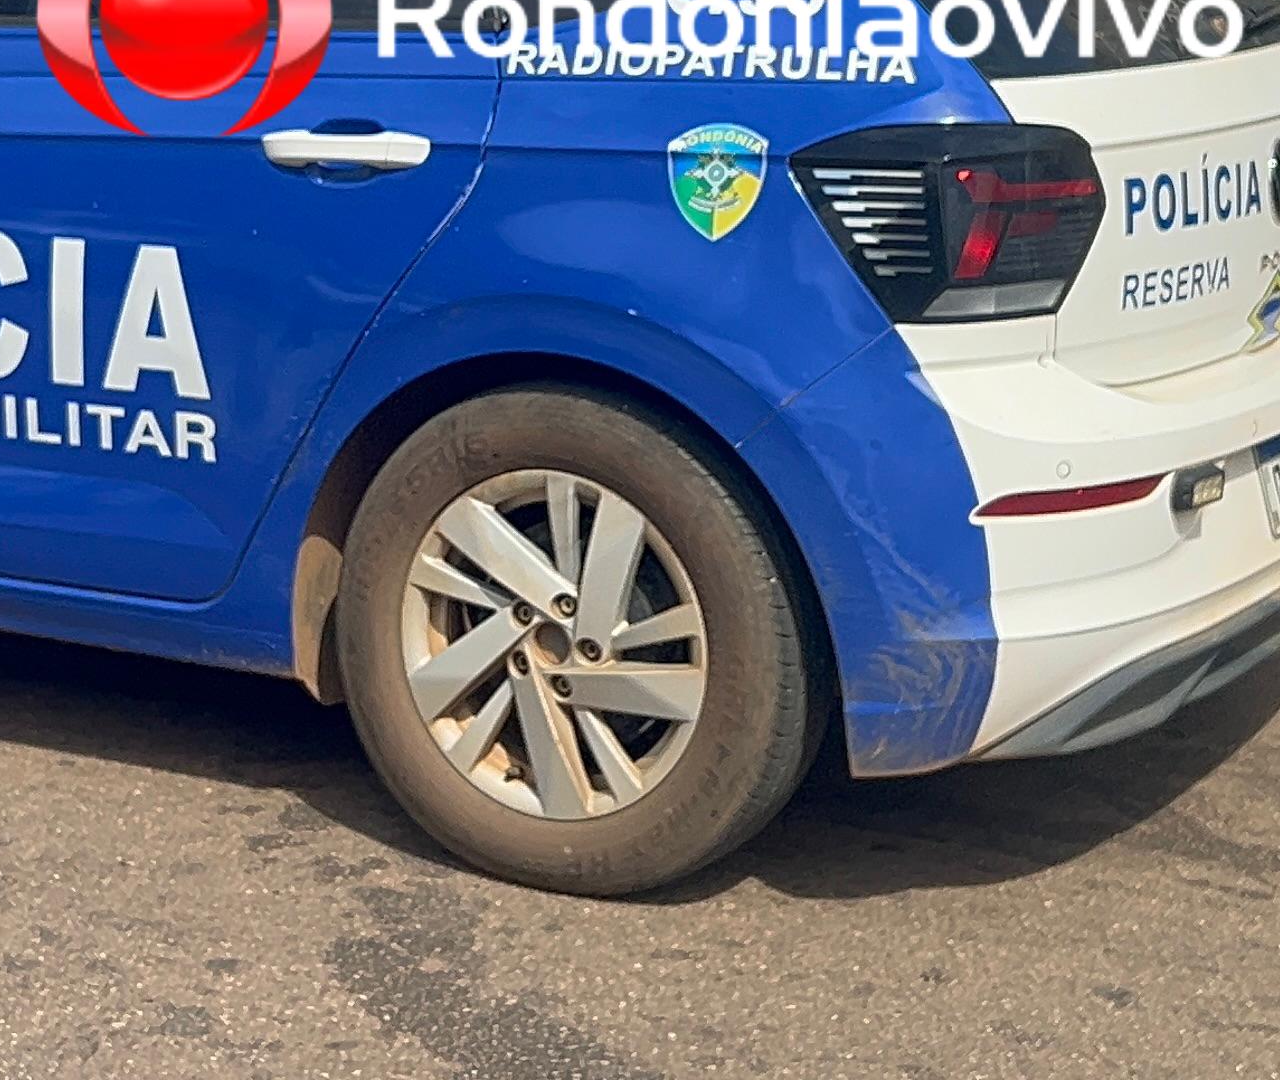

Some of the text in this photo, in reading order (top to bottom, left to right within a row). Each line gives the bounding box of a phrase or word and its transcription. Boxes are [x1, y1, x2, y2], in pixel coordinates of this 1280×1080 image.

[506, 40, 917, 85] RADIOPATRULHA
[1123, 153, 1262, 237] POLÍCIA
[1121, 256, 1231, 311] RESERVA
